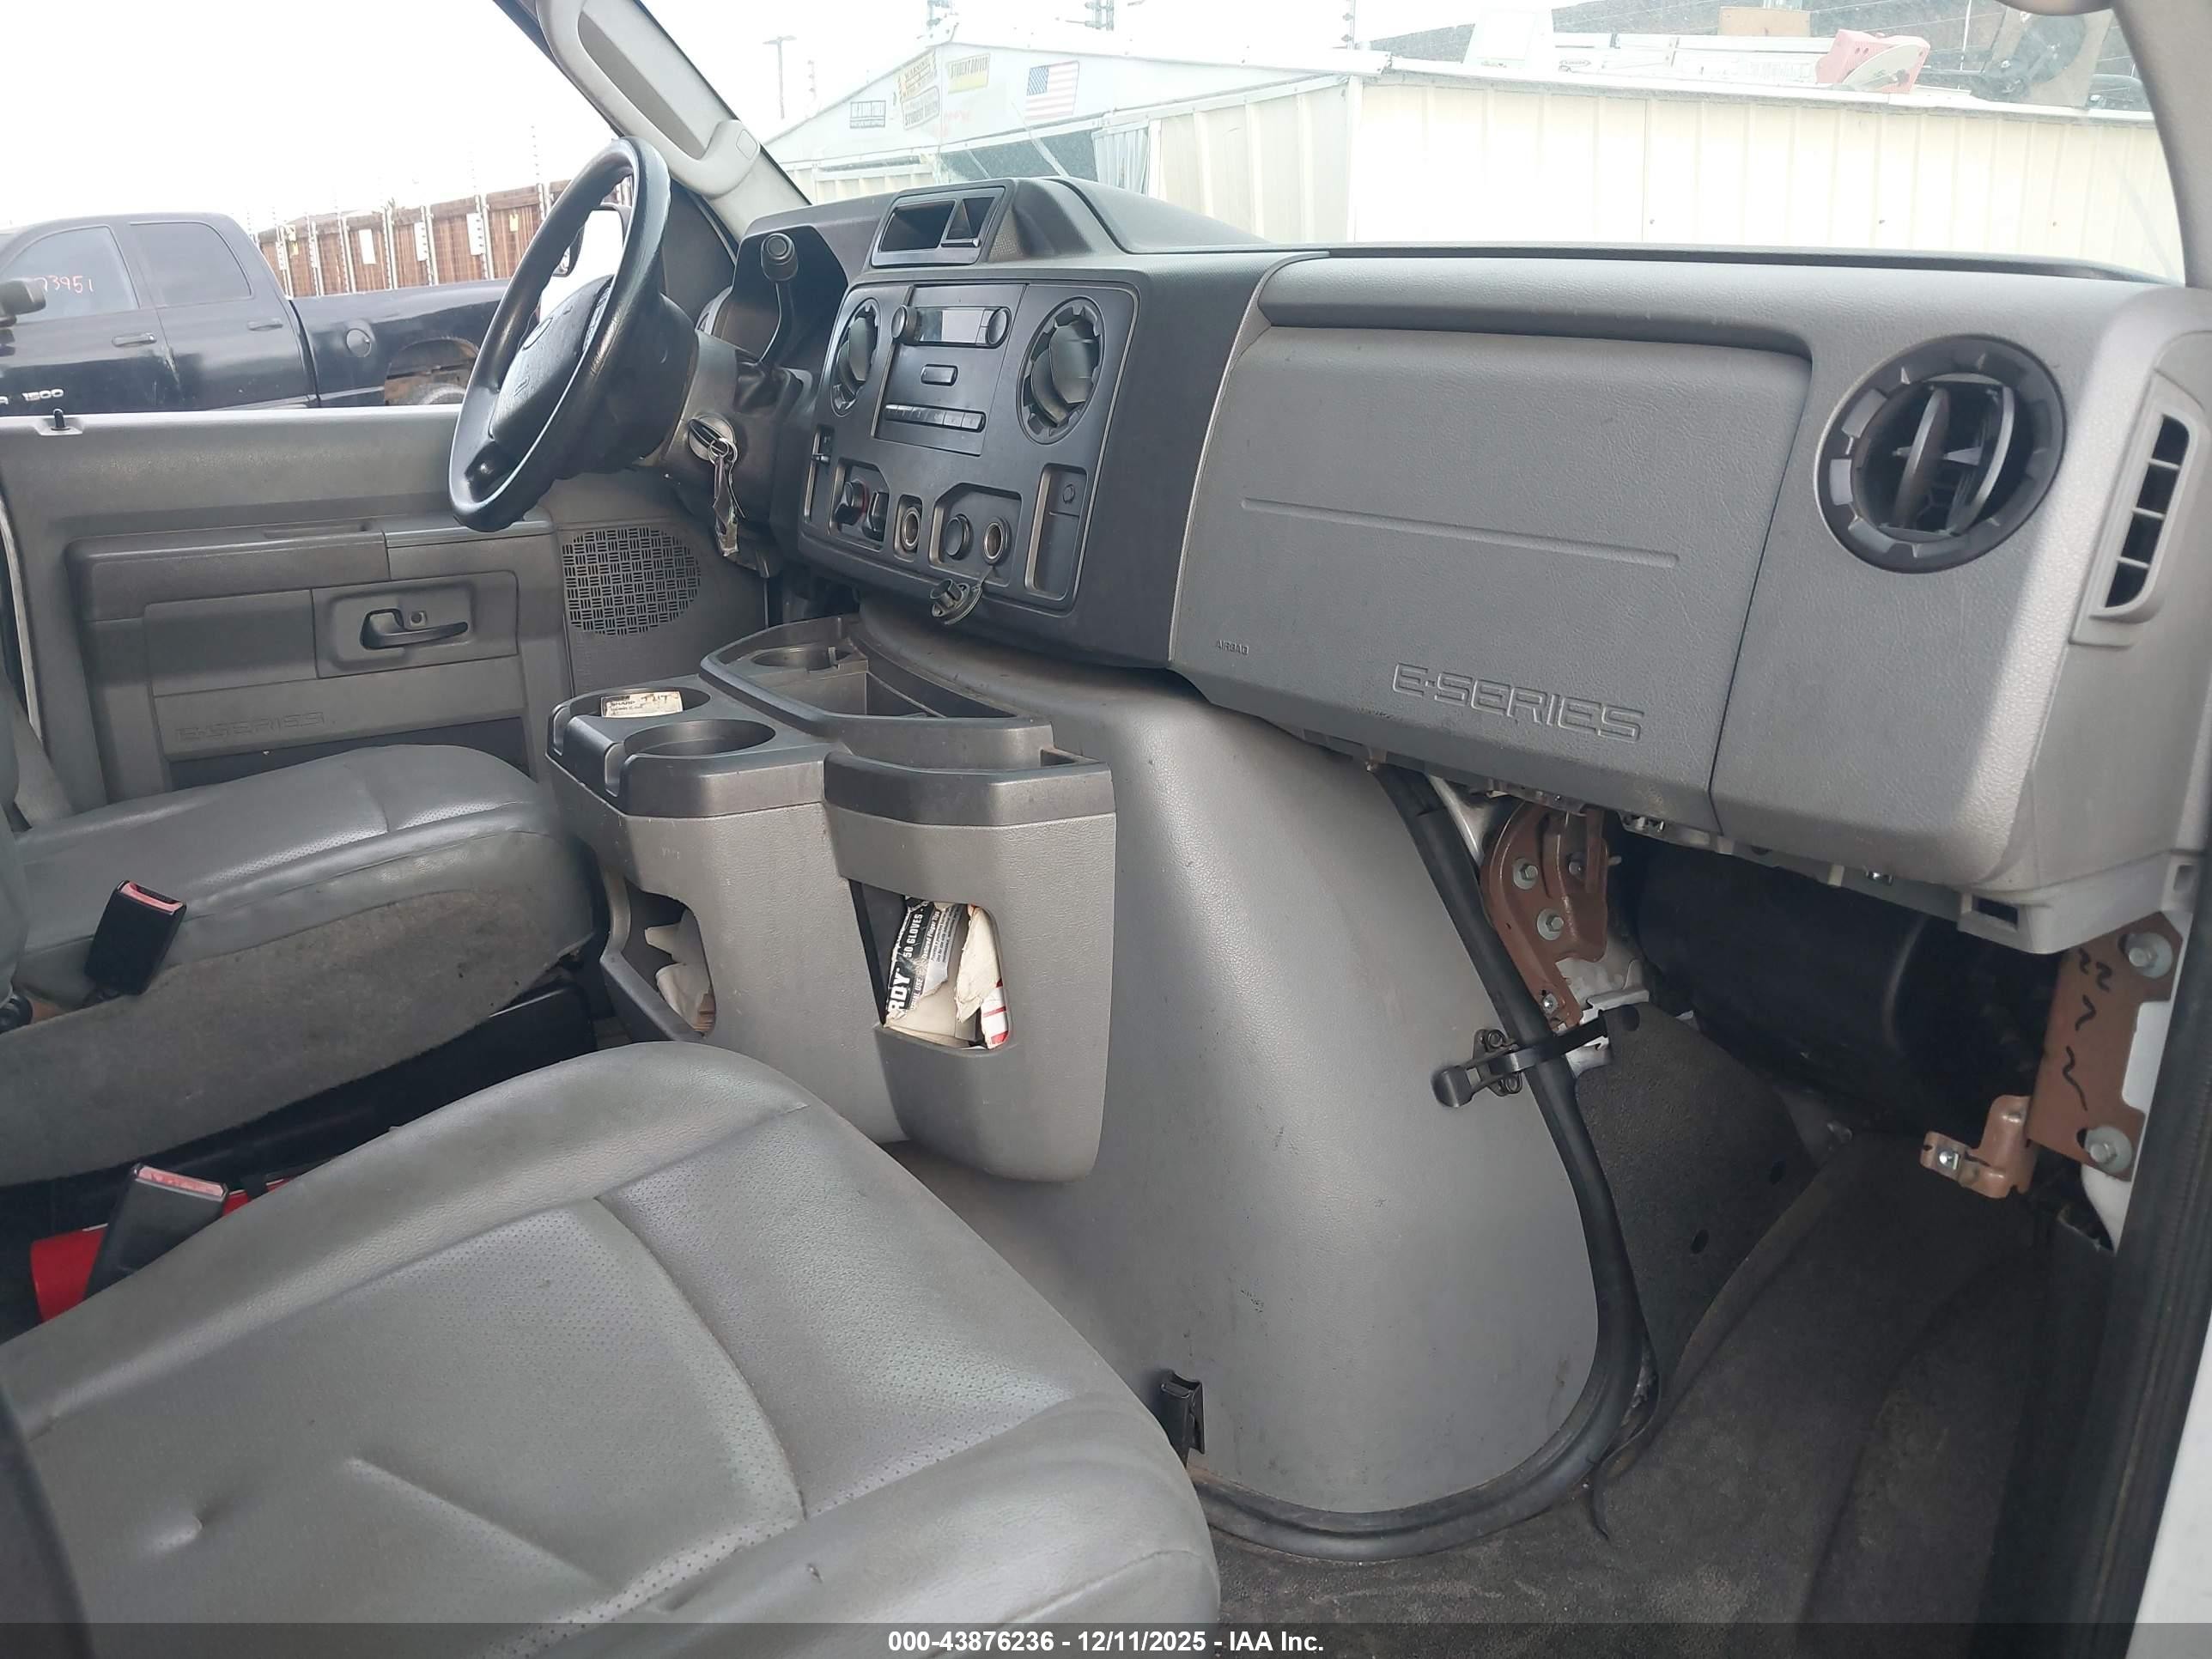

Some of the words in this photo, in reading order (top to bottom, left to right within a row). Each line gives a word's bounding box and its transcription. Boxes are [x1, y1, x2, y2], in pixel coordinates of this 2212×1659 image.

[1392, 662, 1645, 744] E-SERIES
[906, 914, 923, 944] GLOVES
[902, 945, 914, 958] 50
